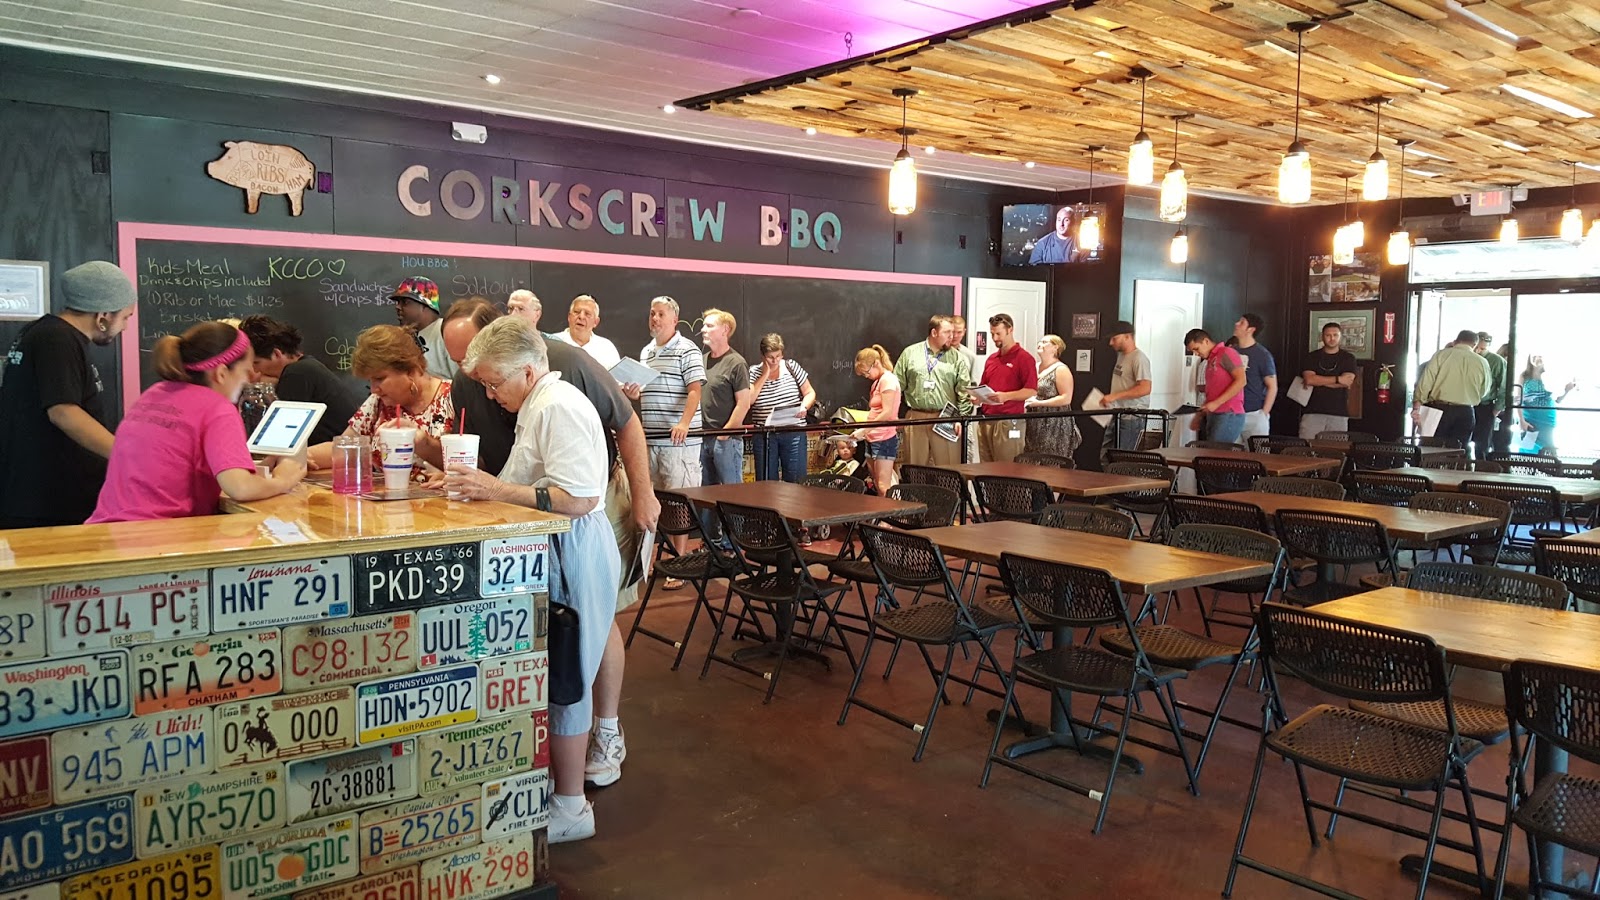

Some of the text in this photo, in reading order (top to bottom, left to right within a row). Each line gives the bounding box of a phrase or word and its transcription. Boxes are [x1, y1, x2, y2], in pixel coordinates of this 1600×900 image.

[252, 149, 280, 164] LOIN
[257, 163, 285, 184] RIBS
[286, 174, 306, 190] HAM
[250, 182, 279, 192] BACON
[398, 165, 842, 253] CORKSCREW BBQ
[148, 257, 230, 276] Kids Meal
[268, 256, 324, 280] KCCO
[452, 275, 486, 296] Sold
[190, 297, 202, 306] or
[208, 294, 236, 308] Mac
[324, 336, 359, 356] Cob
[366, 556, 377, 568] 19
[394, 549, 444, 566] TEXAS
[492, 543, 548, 555] WASHINGTON
[247, 564, 318, 582] Louisiana
[488, 554, 544, 586] 3214
[52, 586, 100, 600] Illinois
[138, 582, 158, 590] Land
[170, 578, 200, 588] Lincoln
[221, 573, 340, 614] HNF 291
[54, 590, 186, 638] 7614 PC
[454, 601, 496, 614] Oregon
[248, 613, 319, 626] SPORTSMAN'S PARADISE
[311, 618, 387, 638] Massachusetts
[424, 618, 468, 654] UUL
[486, 608, 528, 643] 052
[138, 653, 154, 663] 19
[4, 664, 90, 684] Washington
[139, 649, 274, 703] RFA 283
[320, 668, 382, 683] COMMERCIAL
[389, 674, 449, 690] PENNSYLVANIA
[487, 668, 503, 678] MAR
[188, 692, 238, 706] CHATHAM
[282, 692, 338, 707] WYOMING
[487, 674, 544, 710] GREY
[155, 713, 203, 736] Utah!
[291, 706, 338, 742] 000
[398, 719, 442, 734] visitPA.com
[445, 720, 508, 744] Tennessee
[63, 732, 205, 791] 945 APM
[454, 764, 505, 784] Volunteer State
[516, 774, 548, 787] VIRGIN
[160, 776, 263, 804] NEW HAMPSHIRE
[106, 799, 127, 812] MO
[404, 800, 434, 815] Capital
[146, 788, 276, 848] AYR-570
[508, 821, 528, 831] FIRE
[62, 812, 128, 860] 569
[370, 802, 474, 856] B 25265
[256, 826, 326, 854] FLORIDA
[308, 834, 350, 872] GDC
[390, 844, 436, 862] Washington
[444, 852, 482, 872] Alberta
[65, 858, 100, 873] STATE
[100, 860, 182, 886] GEORGIA
[254, 872, 330, 898] SUNSHINE STATE
[352, 869, 414, 894] CAROLINA
